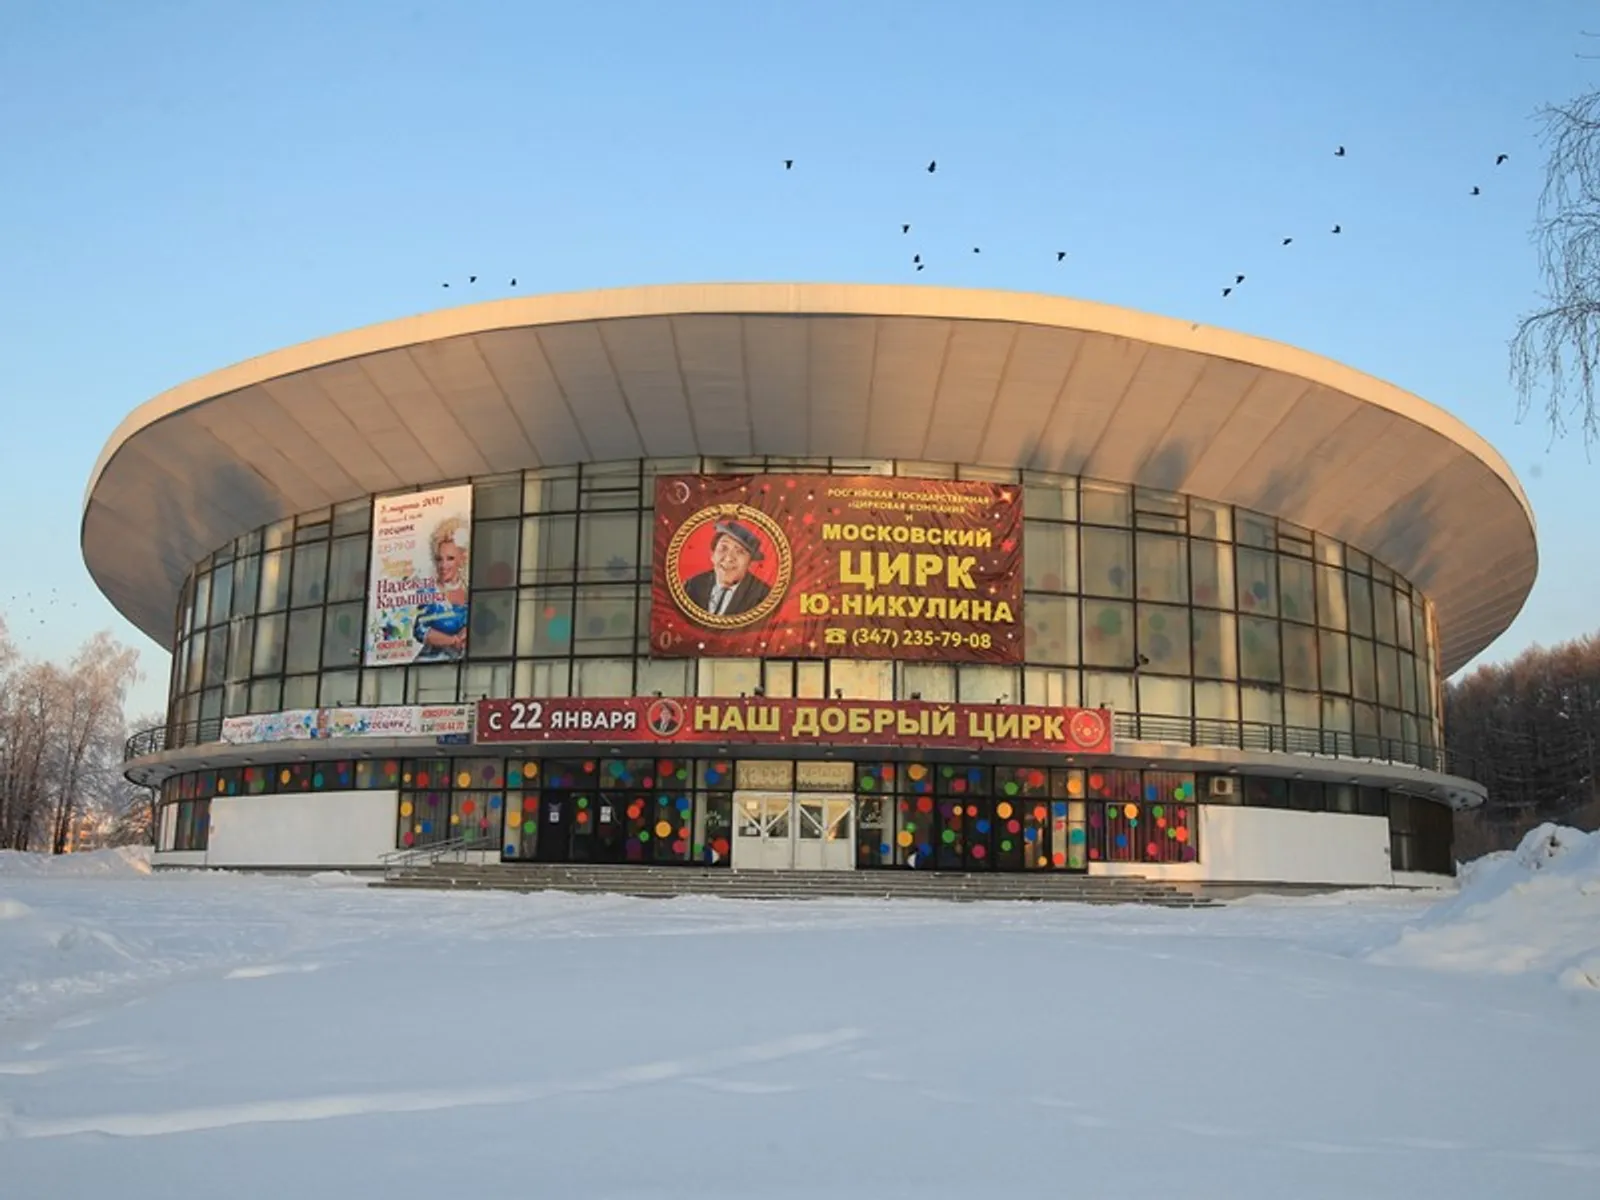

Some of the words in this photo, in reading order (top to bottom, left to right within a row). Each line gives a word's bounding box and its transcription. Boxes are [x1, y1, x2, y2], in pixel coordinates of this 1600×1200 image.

[822, 523, 992, 548] МОСКОВСКИЙ
[839, 550, 977, 590] ЦИРК
[800, 593, 1014, 623] Ю.НИКУЛИНА
[852, 628, 899, 647] (347)
[903, 630, 992, 648] 235-79-08
[510, 702, 543, 729] 22
[550, 711, 637, 730] ЯНВАРЯ
[694, 705, 781, 732] НАШ
[792, 705, 956, 738] ДОБРЫЙ
[968, 713, 1066, 743] ЦИРК
